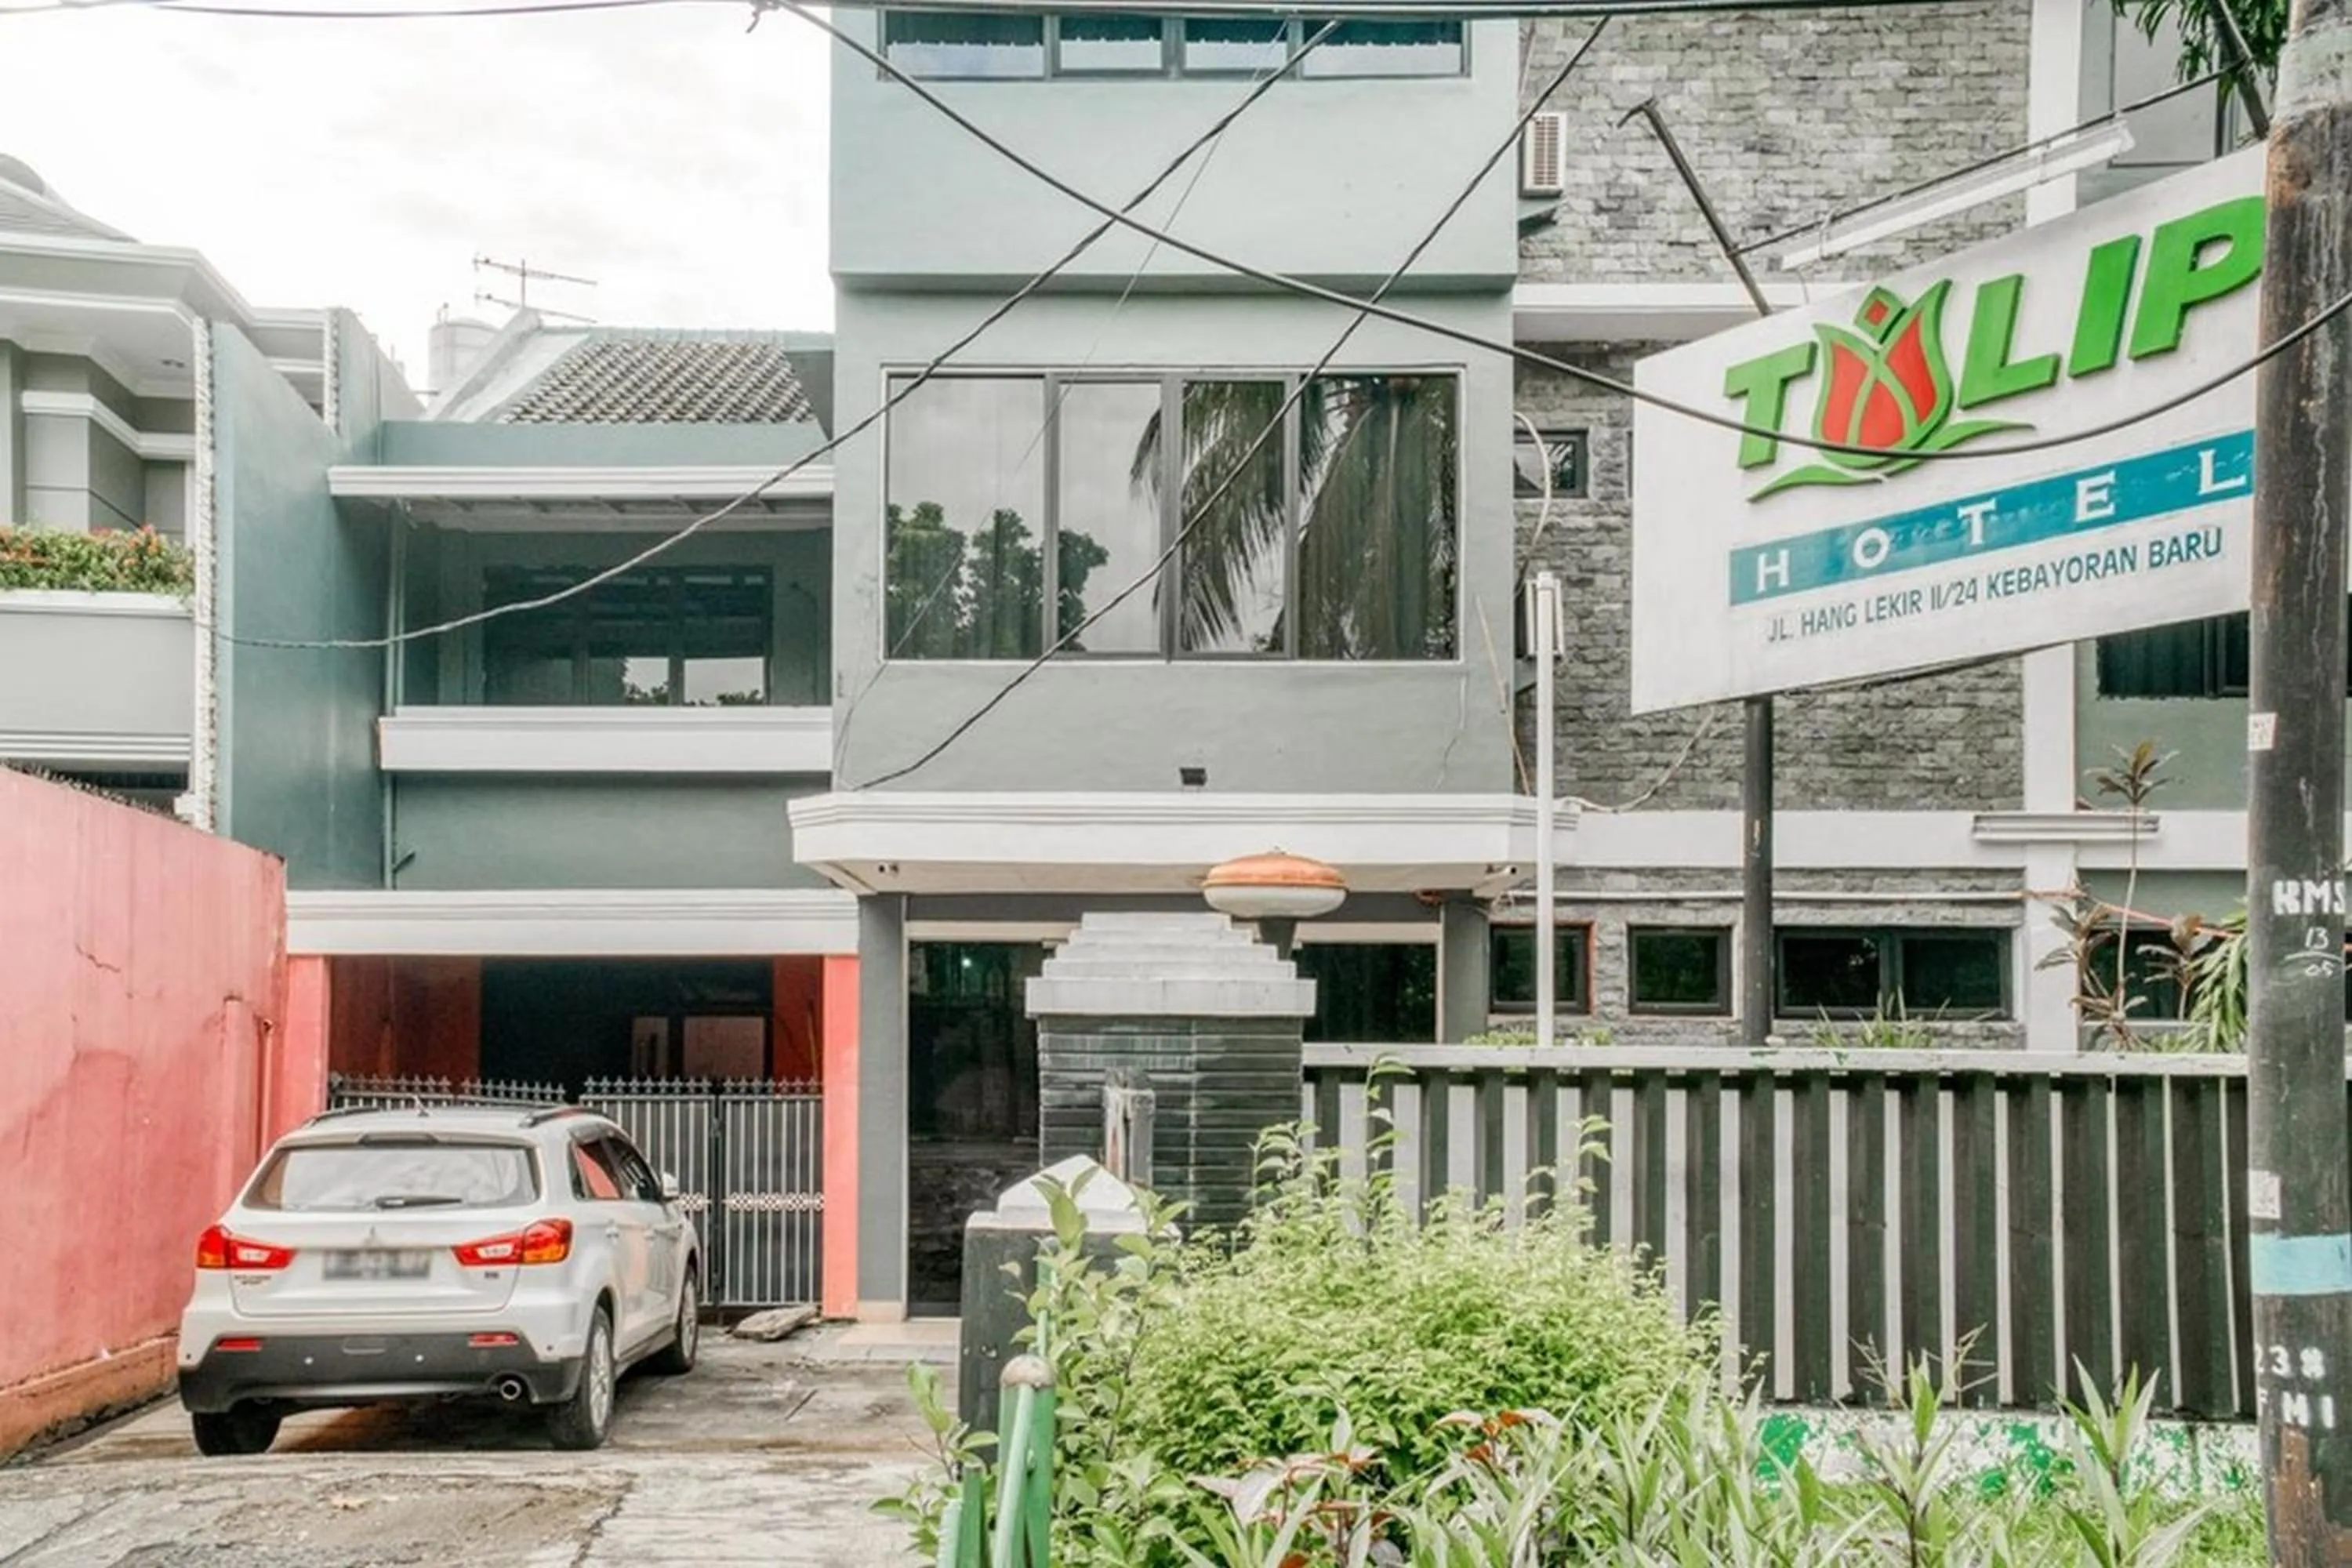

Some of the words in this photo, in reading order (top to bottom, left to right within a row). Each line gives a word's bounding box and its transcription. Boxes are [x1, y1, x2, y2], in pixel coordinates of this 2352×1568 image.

[1725, 195, 2266, 470] TULIP
[1756, 448, 2247, 594] HOTEL
[1768, 615, 1794, 643] JL.
[1801, 602, 1857, 637] HANG
[1865, 589, 1923, 624] LEKIR
[1986, 544, 2138, 601] KEBAYORAN
[2148, 526, 2223, 569] BARU
